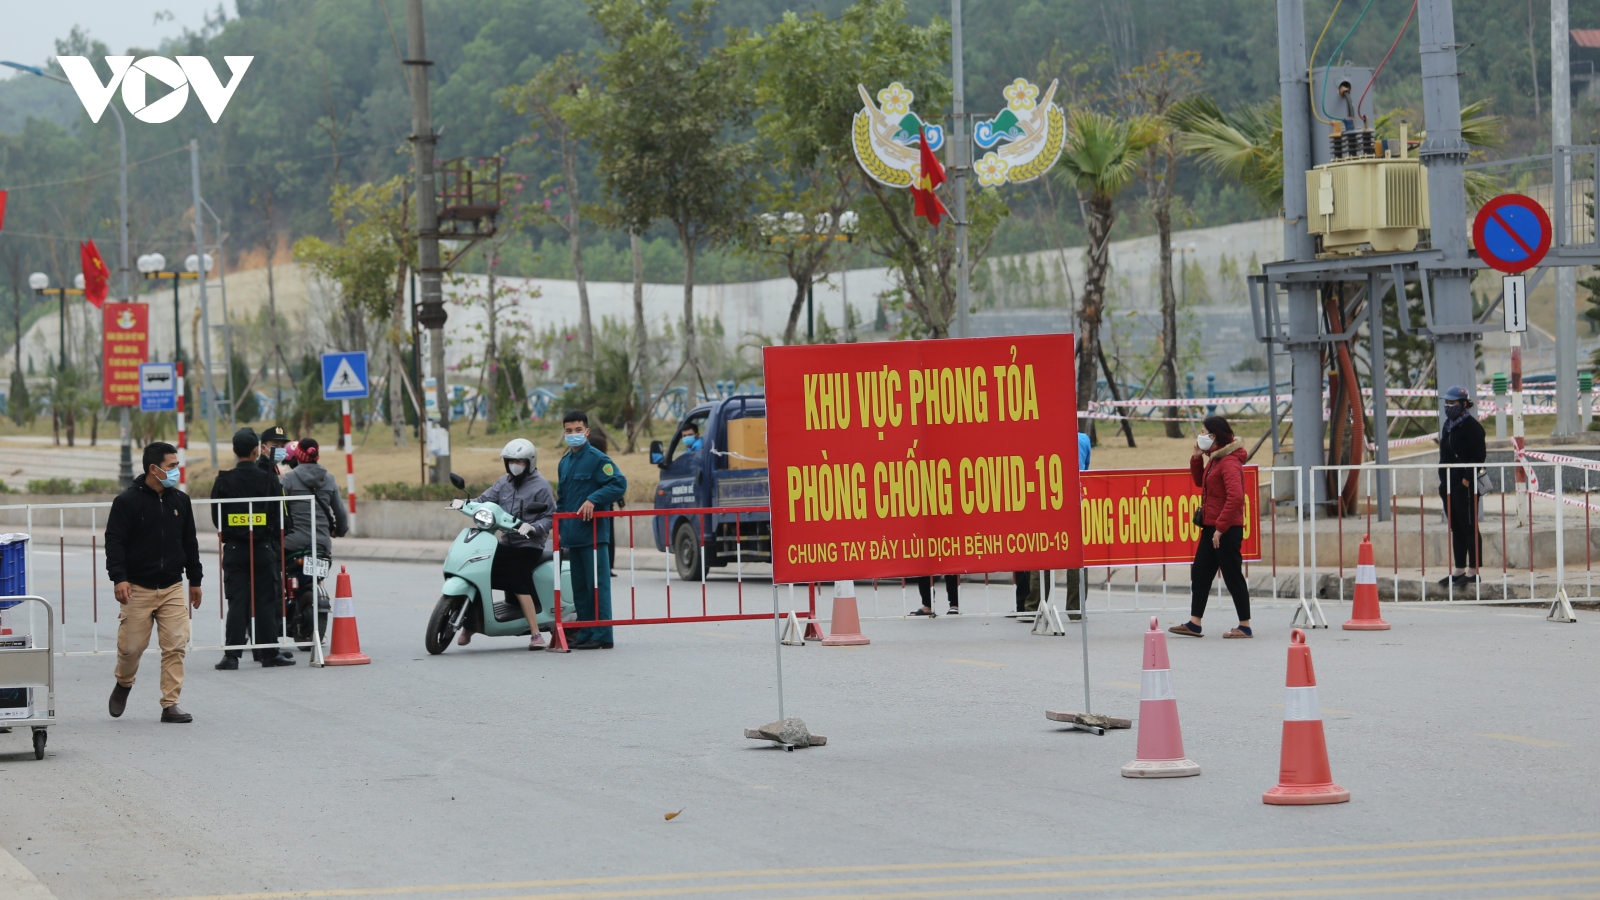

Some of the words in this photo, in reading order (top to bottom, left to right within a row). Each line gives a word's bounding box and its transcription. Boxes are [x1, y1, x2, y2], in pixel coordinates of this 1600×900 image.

[804, 373, 850, 430] KHU
[856, 365, 902, 440] VỰC
[909, 366, 988, 425] PHONG
[994, 345, 1039, 421] TỎA
[787, 450, 867, 522] PHÒNG
[874, 439, 952, 518] CHỐNG
[959, 454, 1063, 514] COVID-19
[1080, 487, 1114, 545] ÒNG
[1119, 480, 1174, 544] CHỐNG
[788, 543, 838, 564] CHUNG
[841, 542, 866, 561] TAY
[870, 535, 898, 560] ĐẨY
[902, 533, 924, 559] LÙI
[928, 537, 960, 562] DỊCH
[965, 531, 1002, 560] BỆNH
[1006, 531, 1069, 554] COVID-19
